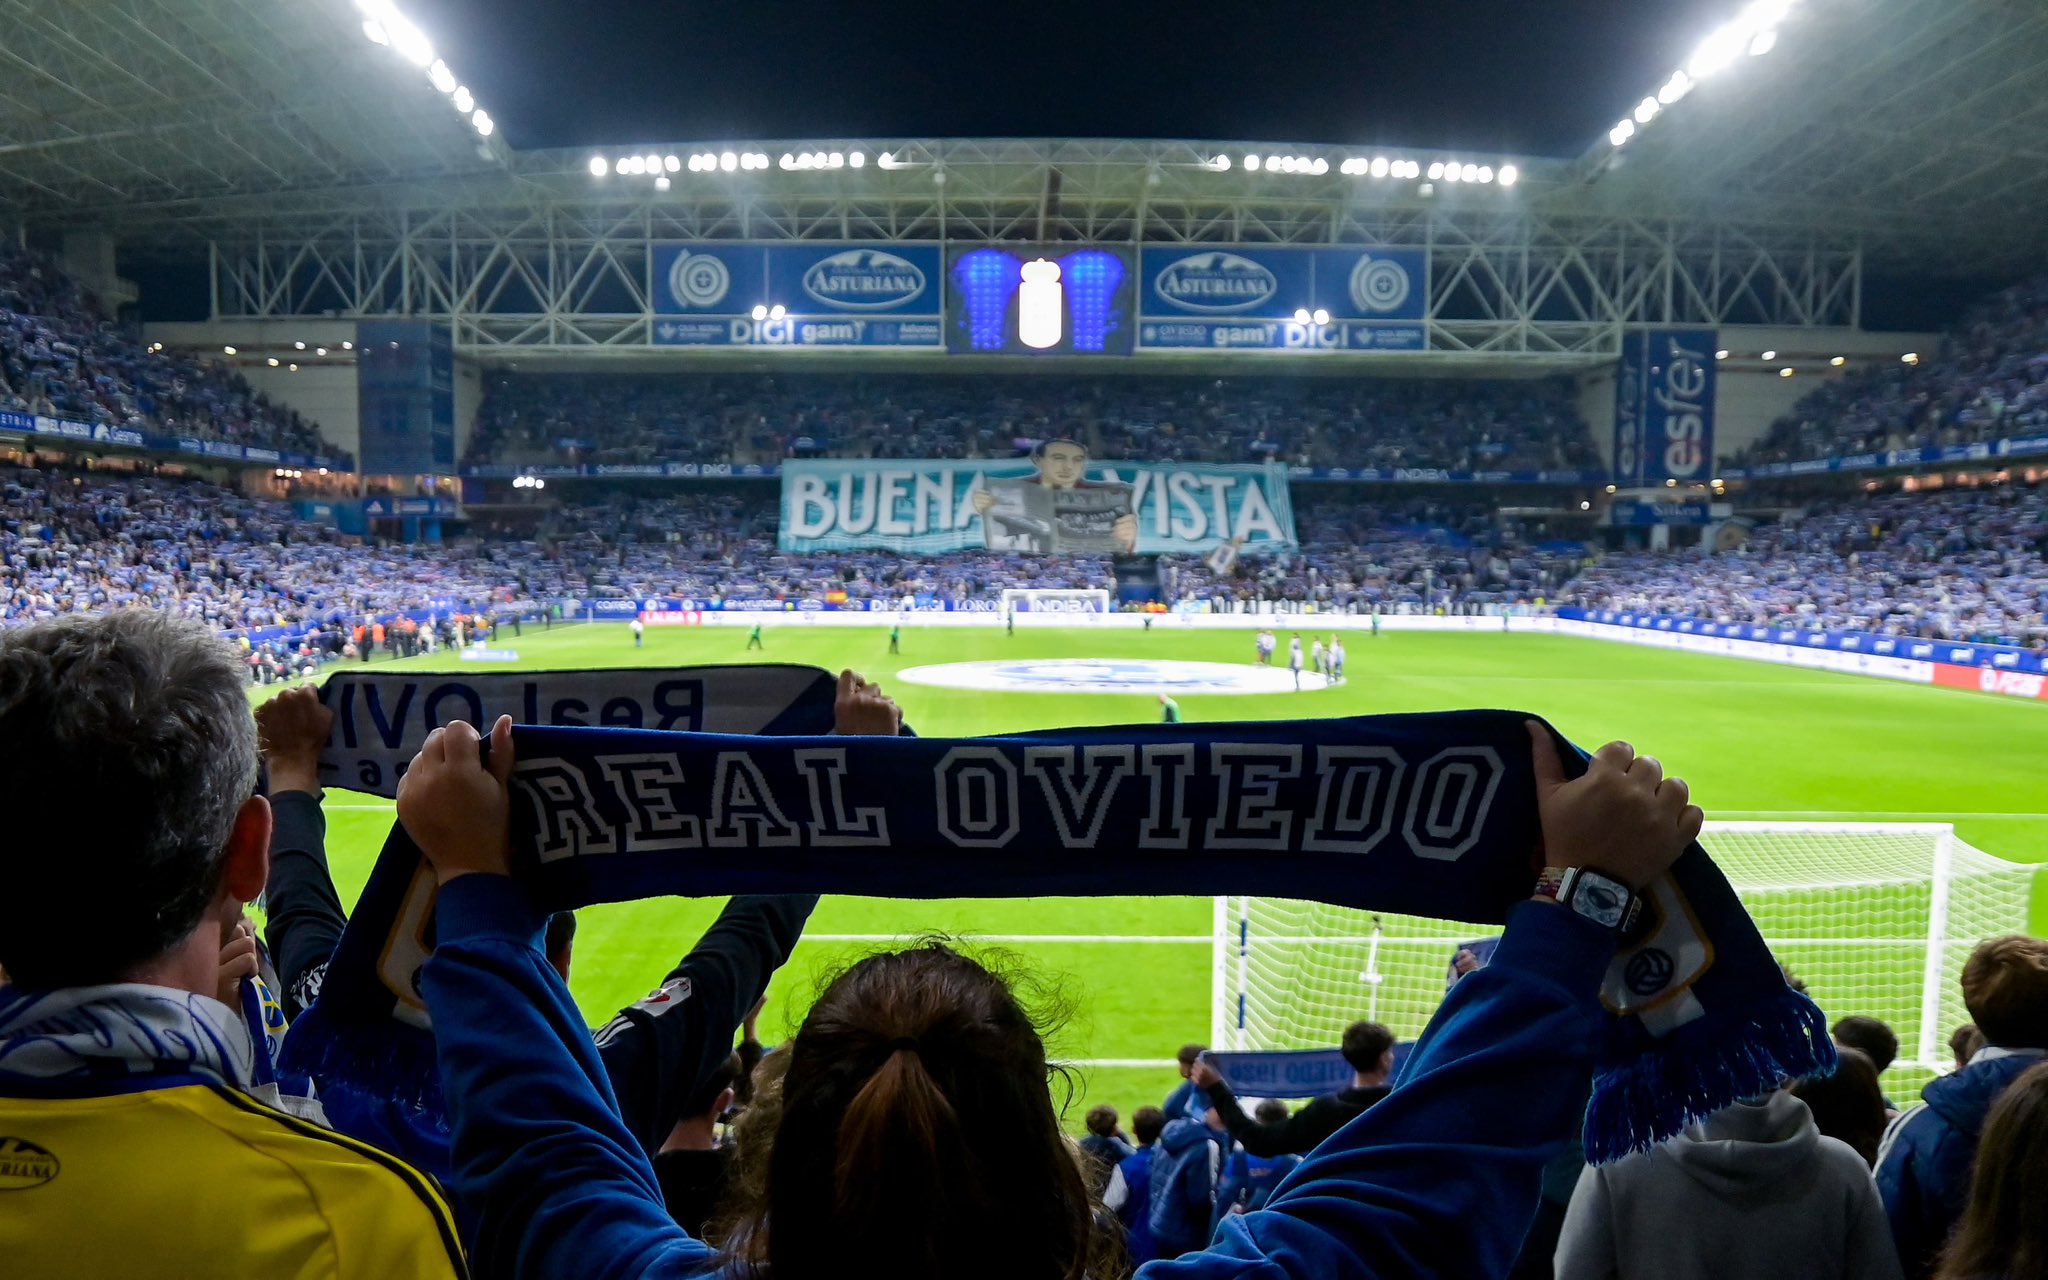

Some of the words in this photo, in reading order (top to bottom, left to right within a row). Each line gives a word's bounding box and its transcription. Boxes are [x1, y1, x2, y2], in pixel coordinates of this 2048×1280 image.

[812, 269, 917, 291] ASTURIANA
[1163, 271, 1269, 293] ASTURIANA
[730, 319, 794, 342] DIGI
[1286, 324, 1348, 347] DIGI
[513, 747, 892, 864] REAL
[933, 743, 1505, 862] OVIEDO
